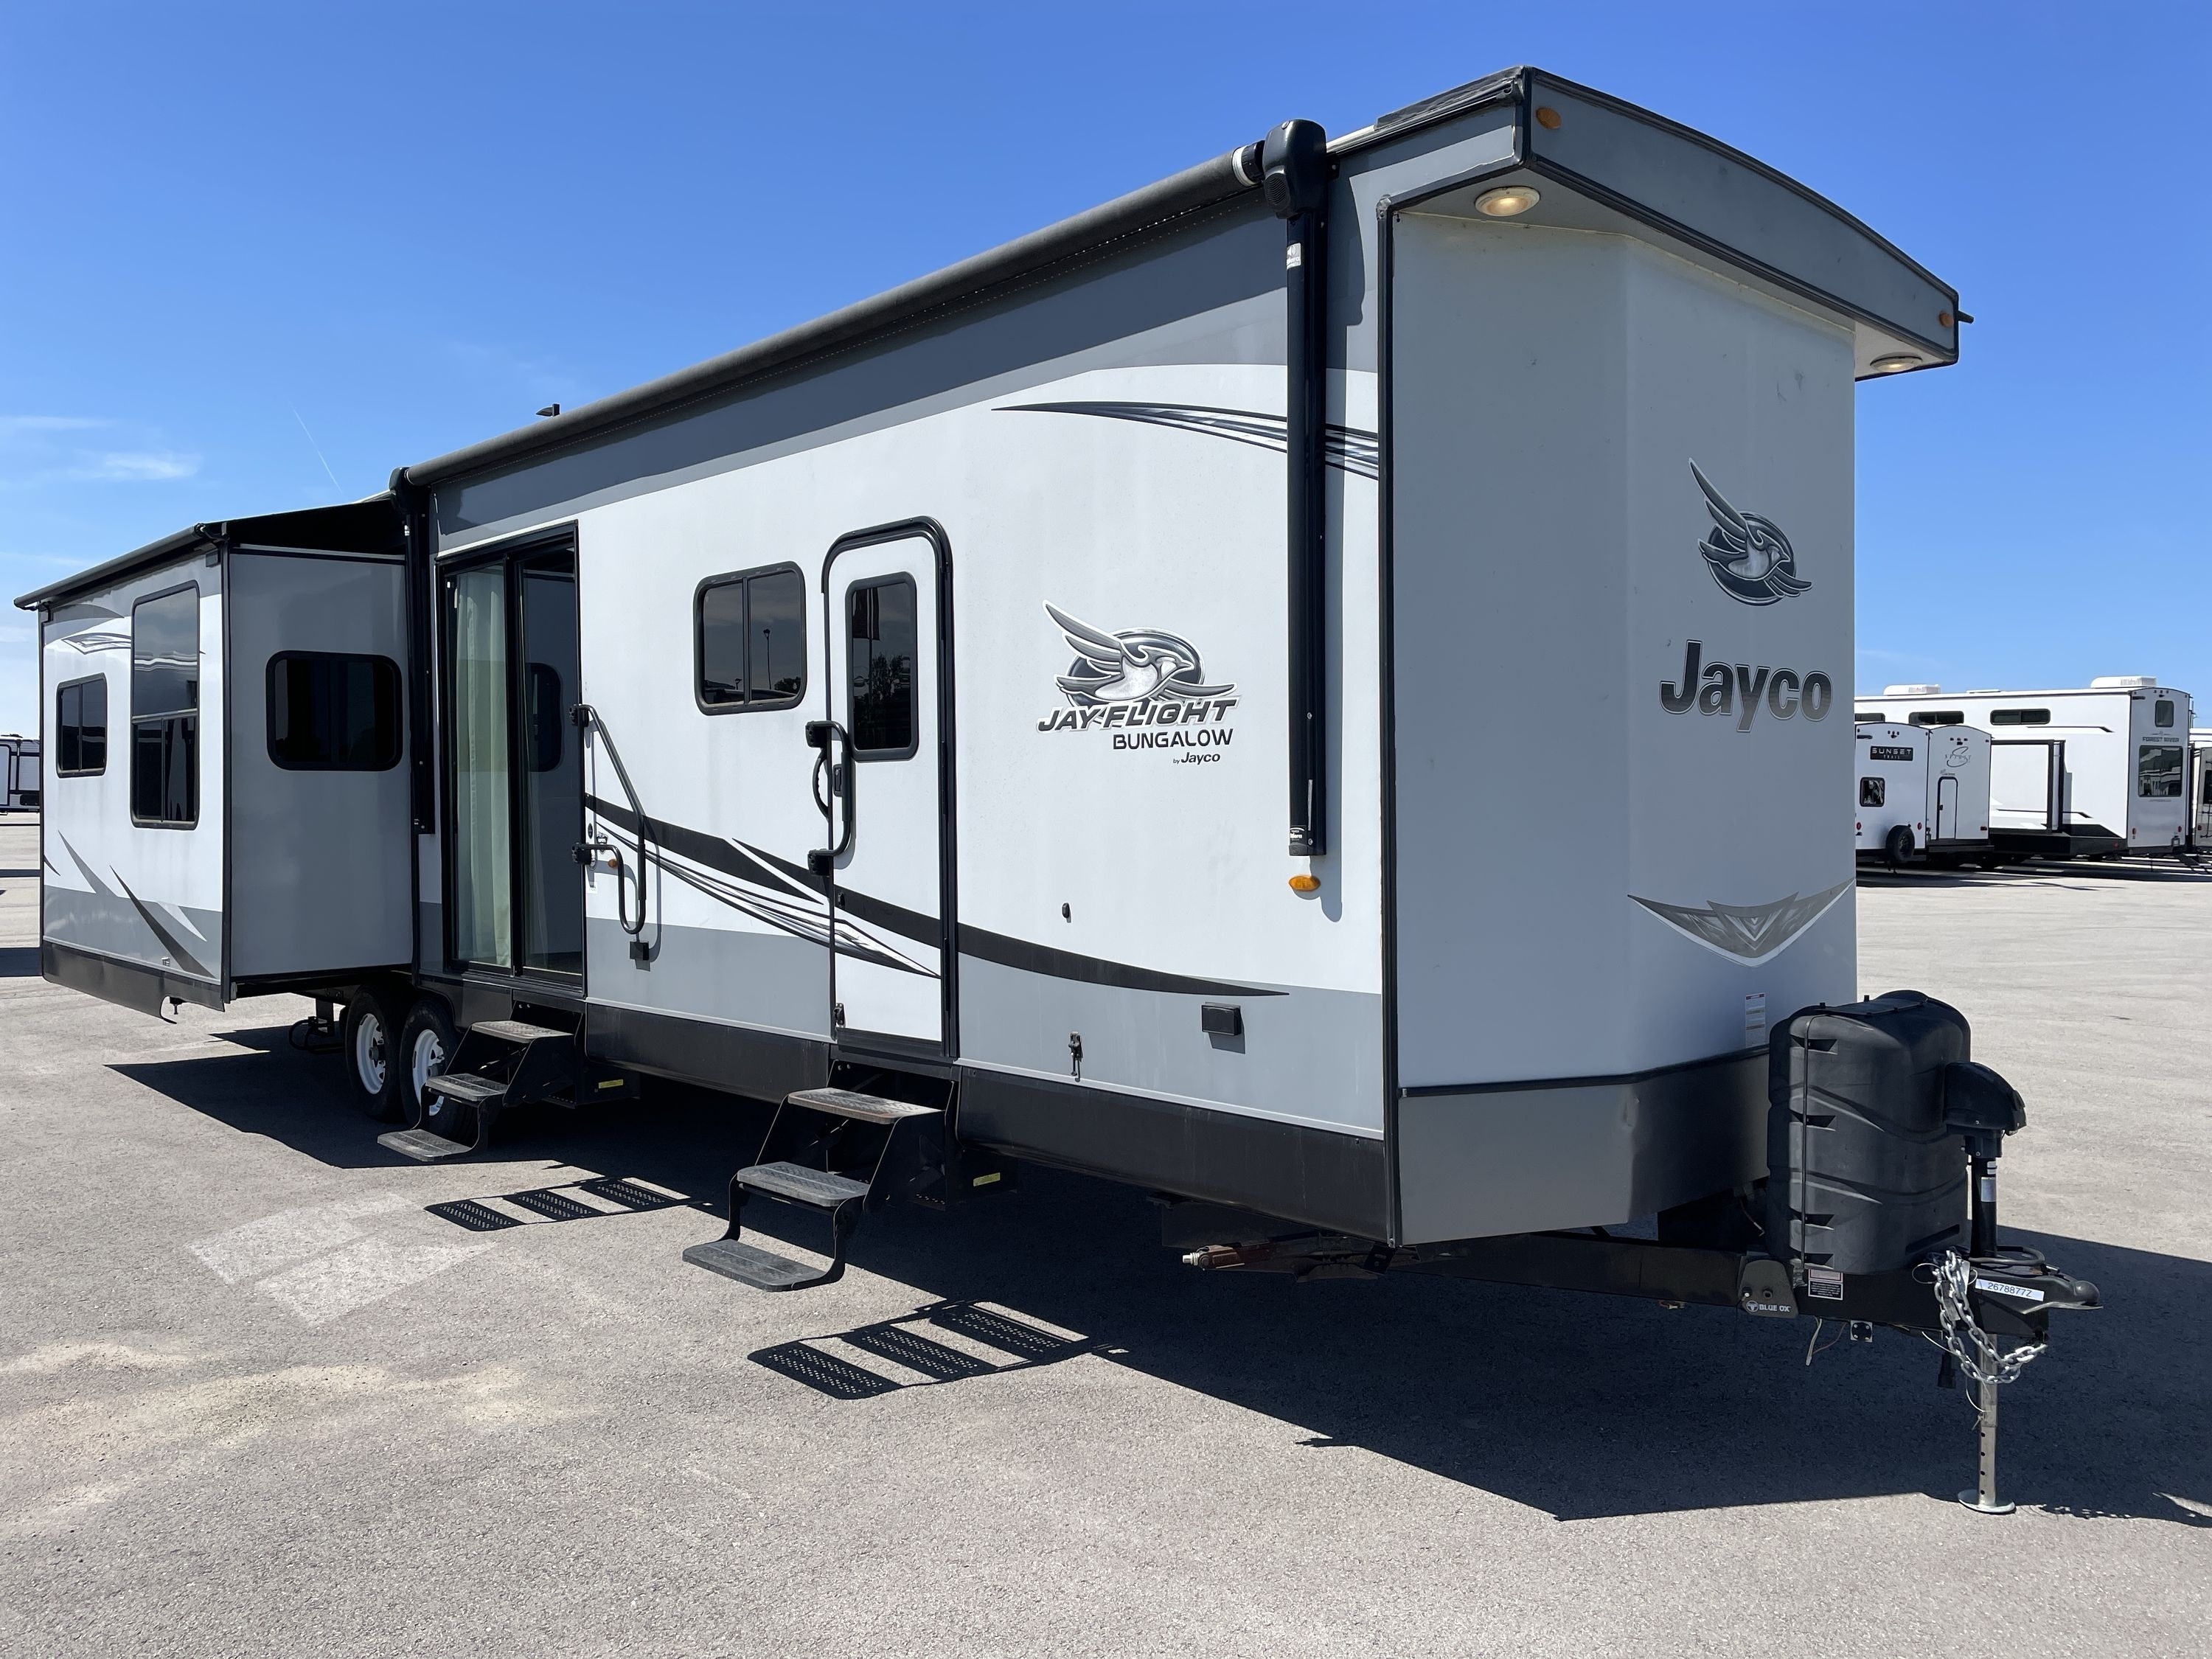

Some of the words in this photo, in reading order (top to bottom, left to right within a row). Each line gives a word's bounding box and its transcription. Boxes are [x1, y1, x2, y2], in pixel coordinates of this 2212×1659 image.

[1660, 639, 1833, 733] Jayco
[1037, 708, 1102, 731] JAY
[1102, 699, 1237, 728] FLIGHT
[1113, 728, 1234, 750] BUNGALOW
[1180, 751, 1221, 765] Jayco
[1871, 747, 1912, 755] SUNSET
[1759, 1304, 1778, 1312] BLUE
